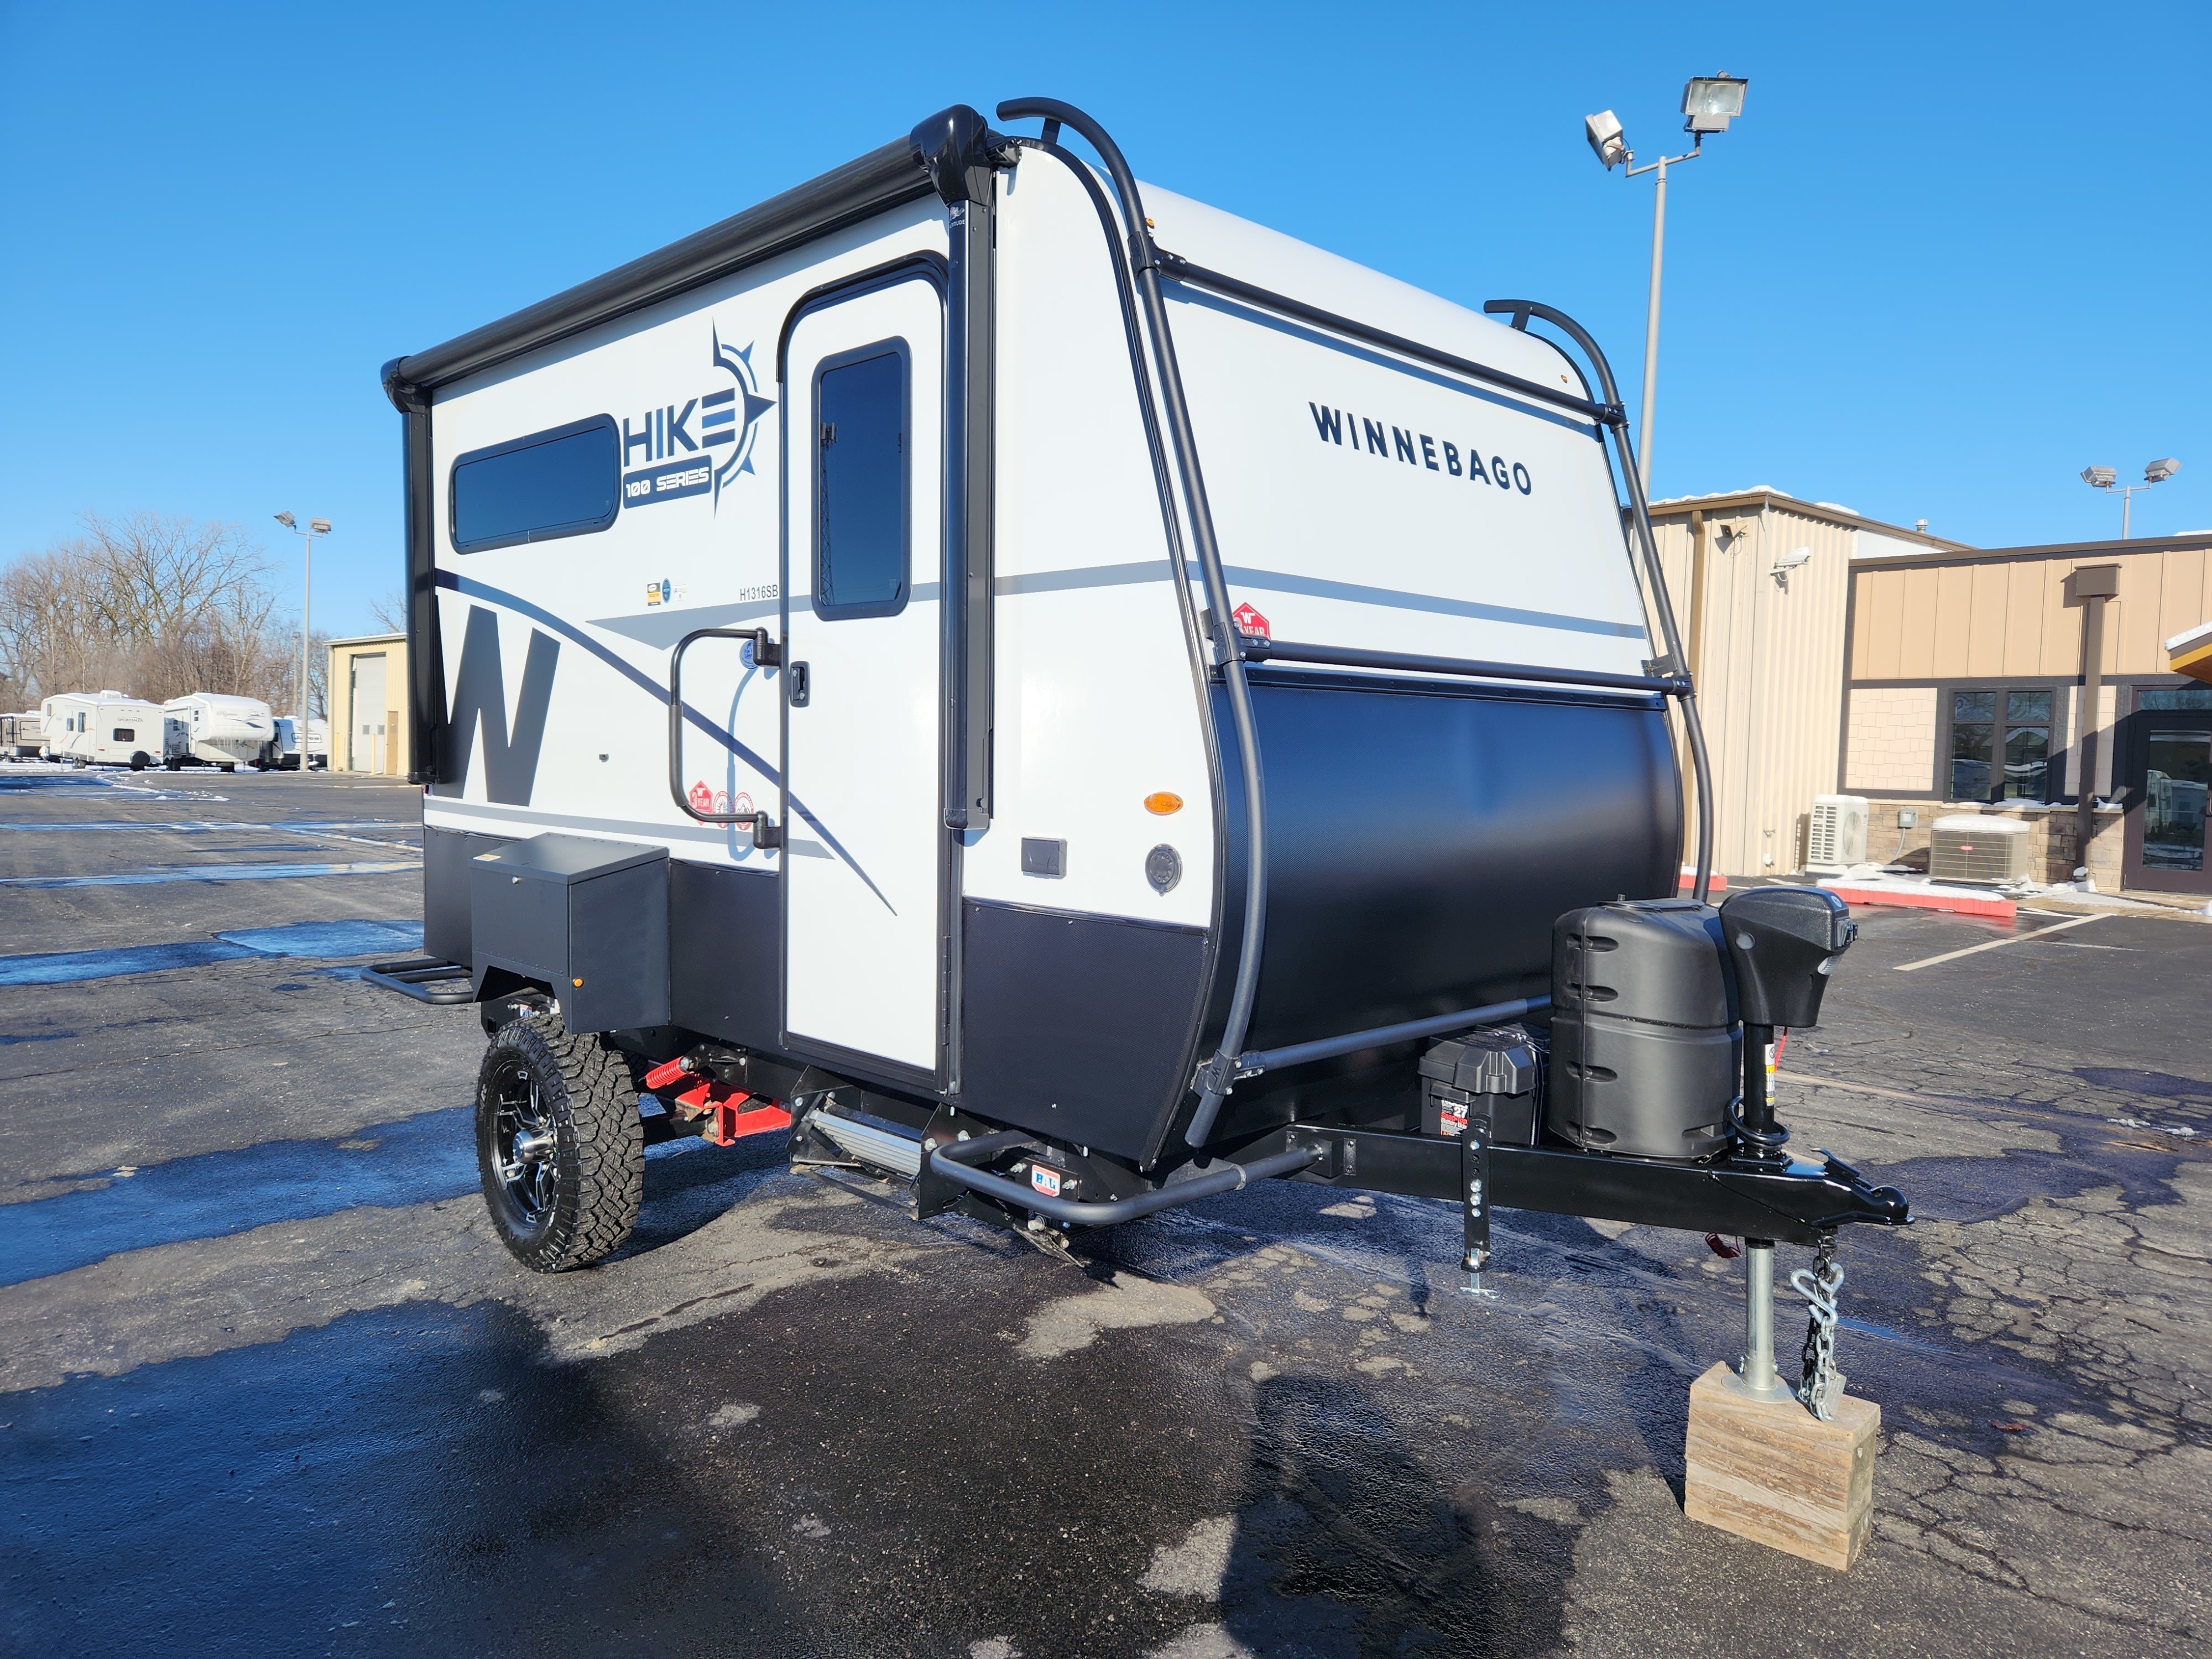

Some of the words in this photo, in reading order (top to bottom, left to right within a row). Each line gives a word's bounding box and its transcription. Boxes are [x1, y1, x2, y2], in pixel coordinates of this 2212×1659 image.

[623, 387, 735, 467] HIKE
[1308, 401, 1532, 495] WINNEBAGO
[625, 479, 651, 498] 100
[656, 467, 709, 492] SERIES
[739, 584, 779, 601] H1316SB
[1243, 625, 1266, 637] YEAR
[697, 798, 709, 807] YEAR
[1453, 1106, 1468, 1119] 27
